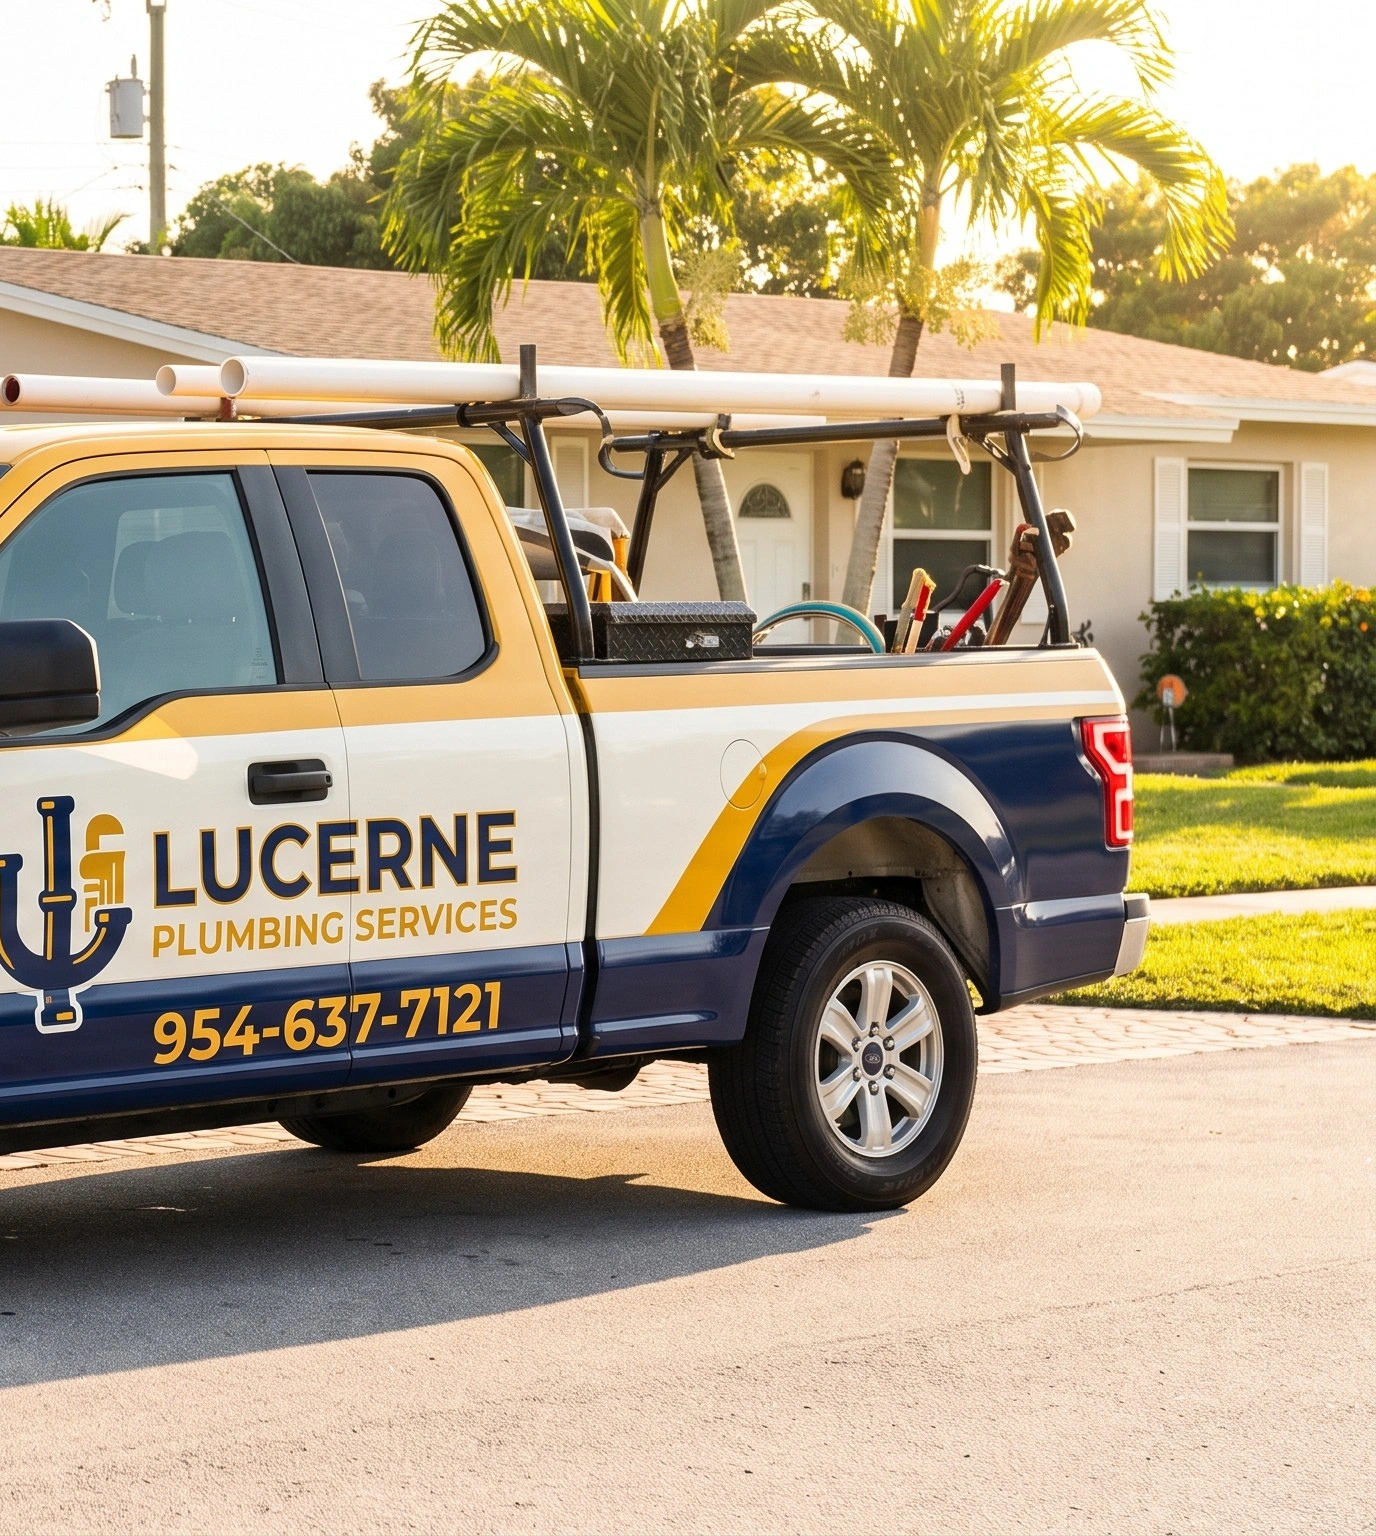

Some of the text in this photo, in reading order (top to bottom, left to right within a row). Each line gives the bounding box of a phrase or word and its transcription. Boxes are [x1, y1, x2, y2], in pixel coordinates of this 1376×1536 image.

[153, 811, 518, 908] LUCERNE
[152, 897, 518, 958] PLUMBING SERVICES
[153, 981, 502, 1065] 954-637-7121
